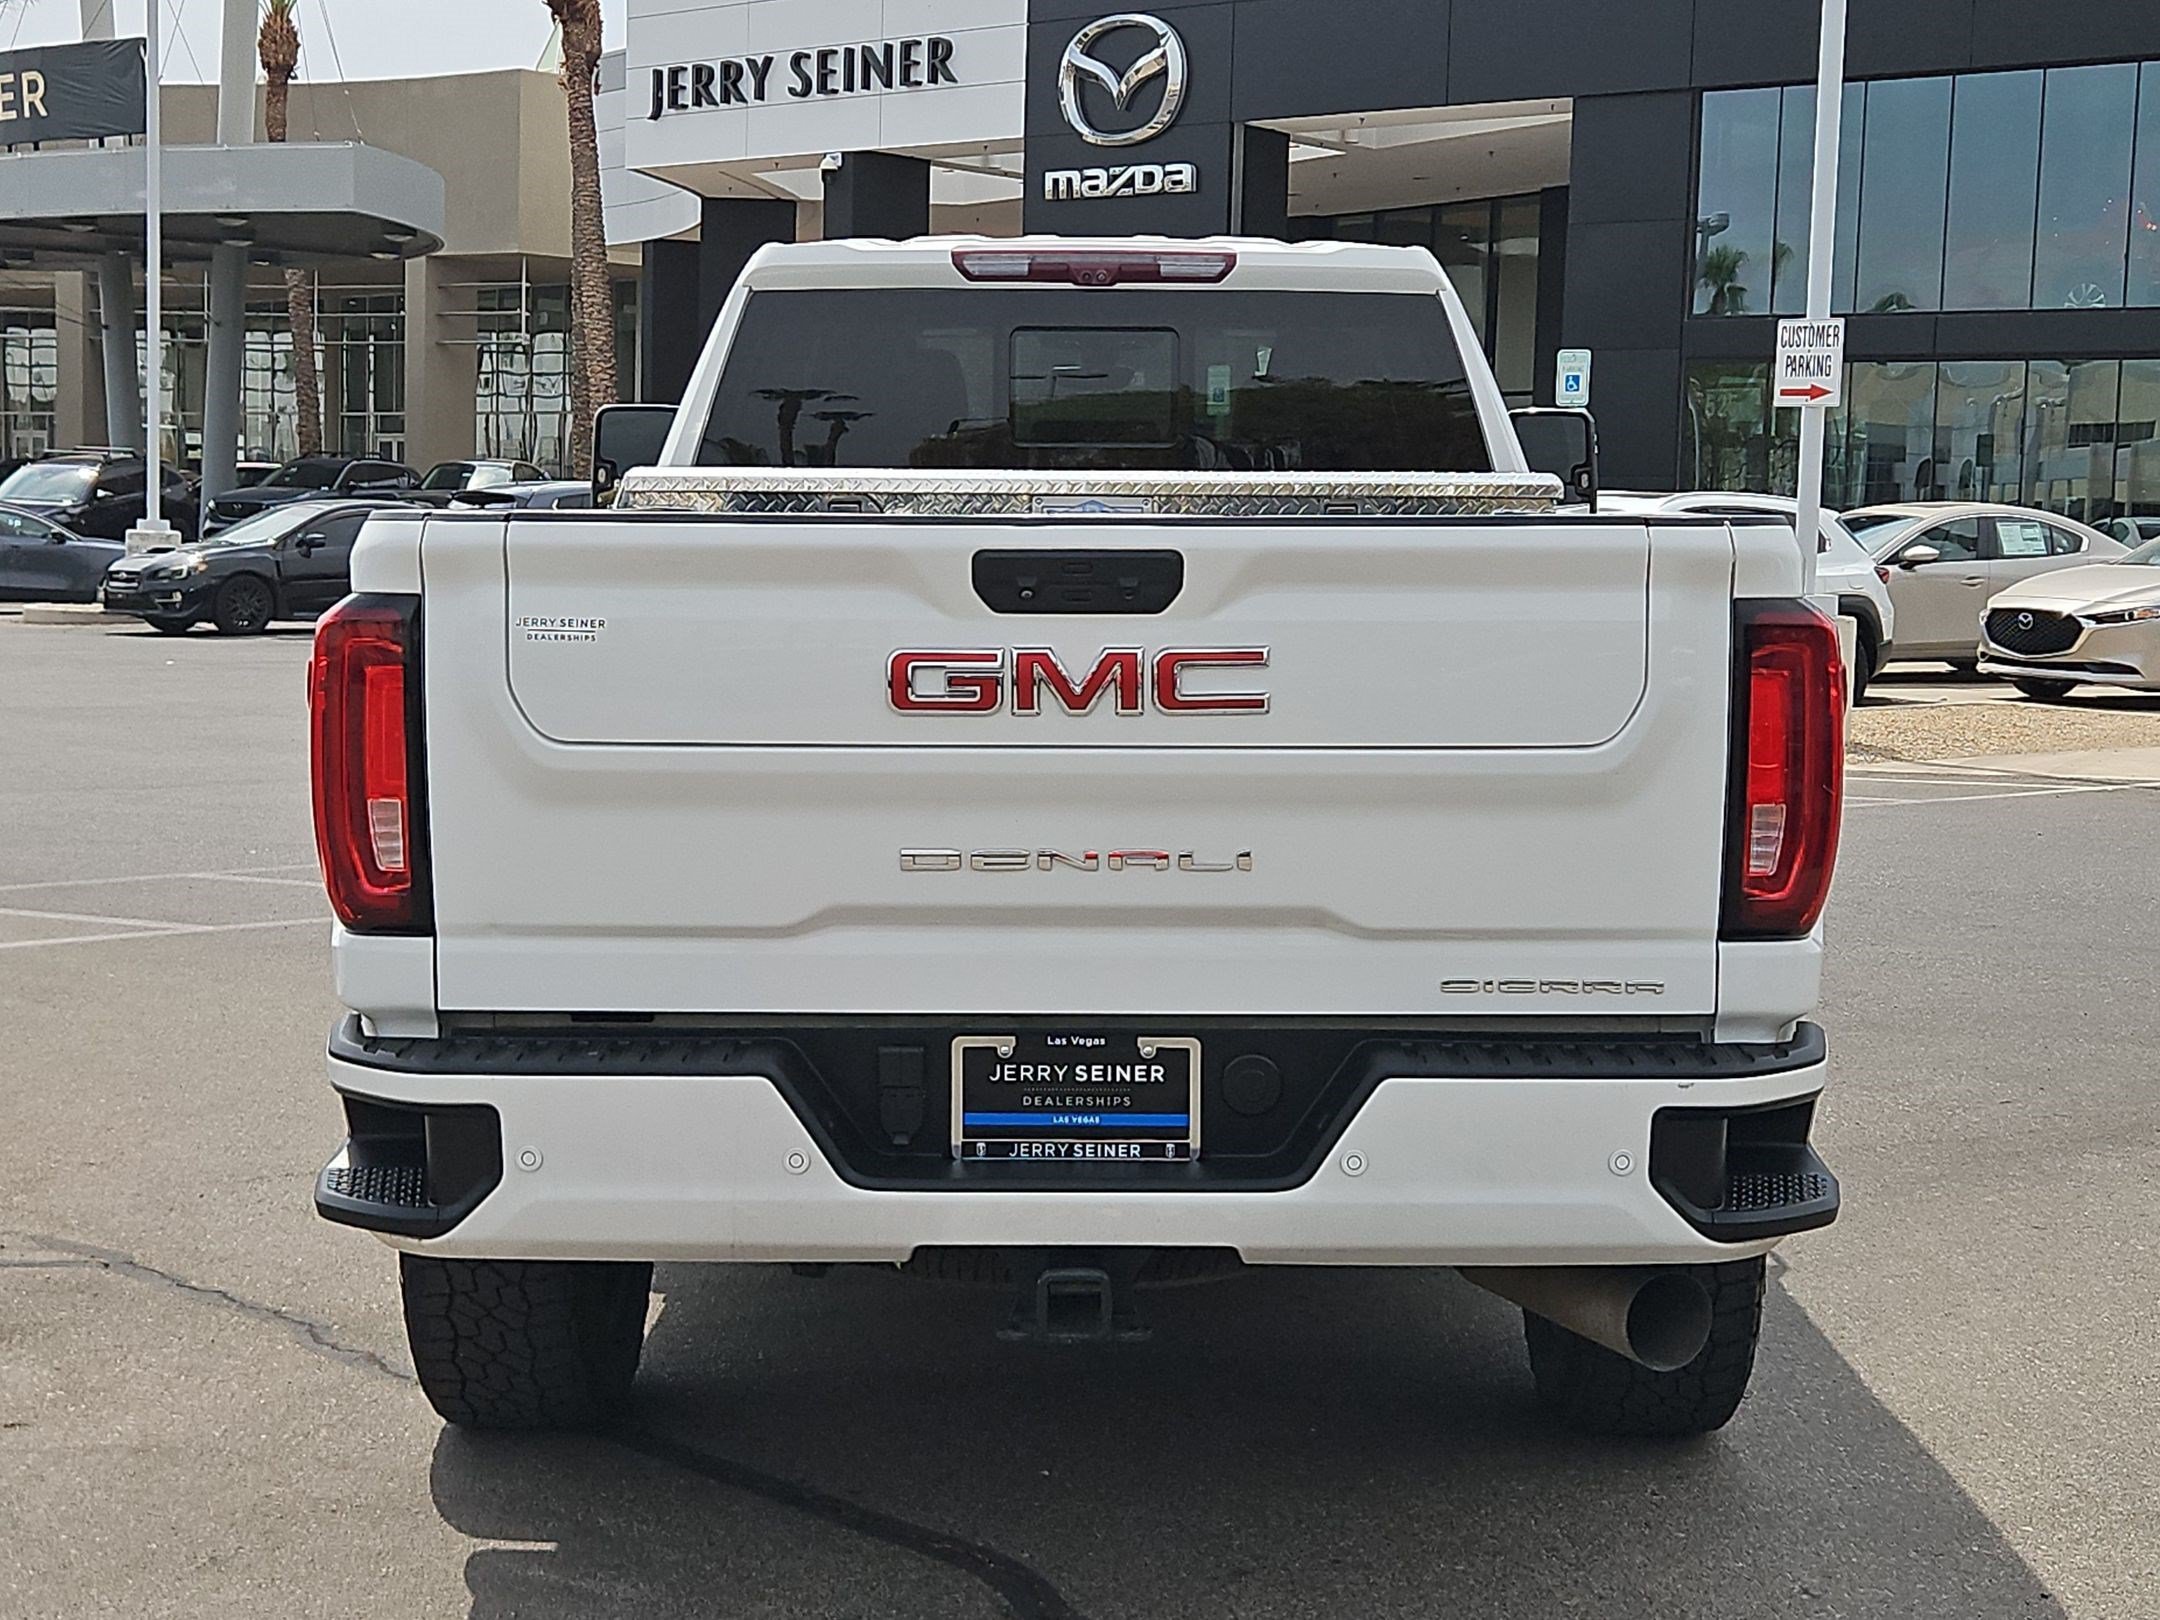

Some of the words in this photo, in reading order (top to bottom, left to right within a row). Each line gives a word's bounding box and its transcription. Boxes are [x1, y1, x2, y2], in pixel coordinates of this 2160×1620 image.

[647, 56, 774, 121] JERRY
[787, 37, 958, 98] SEINER
[1780, 324, 1840, 348] CUSTOMER
[1785, 354, 1832, 378] PARKING
[515, 617, 557, 628] JERRY
[560, 618, 606, 629] SEINER
[526, 633, 596, 642] DEALERSHIPS
[886, 645, 1270, 716] GMC
[900, 847, 1253, 871] DENALI
[1440, 978, 1665, 994] SIERRA
[1047, 1036, 1067, 1046] Las
[1071, 1036, 1106, 1048] Vegas
[988, 1063, 1068, 1082] JERRY
[1075, 1064, 1165, 1083] SEINER
[1022, 1095, 1132, 1107] DEALERSHIPS
[1052, 1116, 1069, 1124] LAS
[1072, 1116, 1100, 1124] VEGAS
[1008, 1143, 1069, 1158] JERRY
[1072, 1143, 1141, 1158] SEINER
